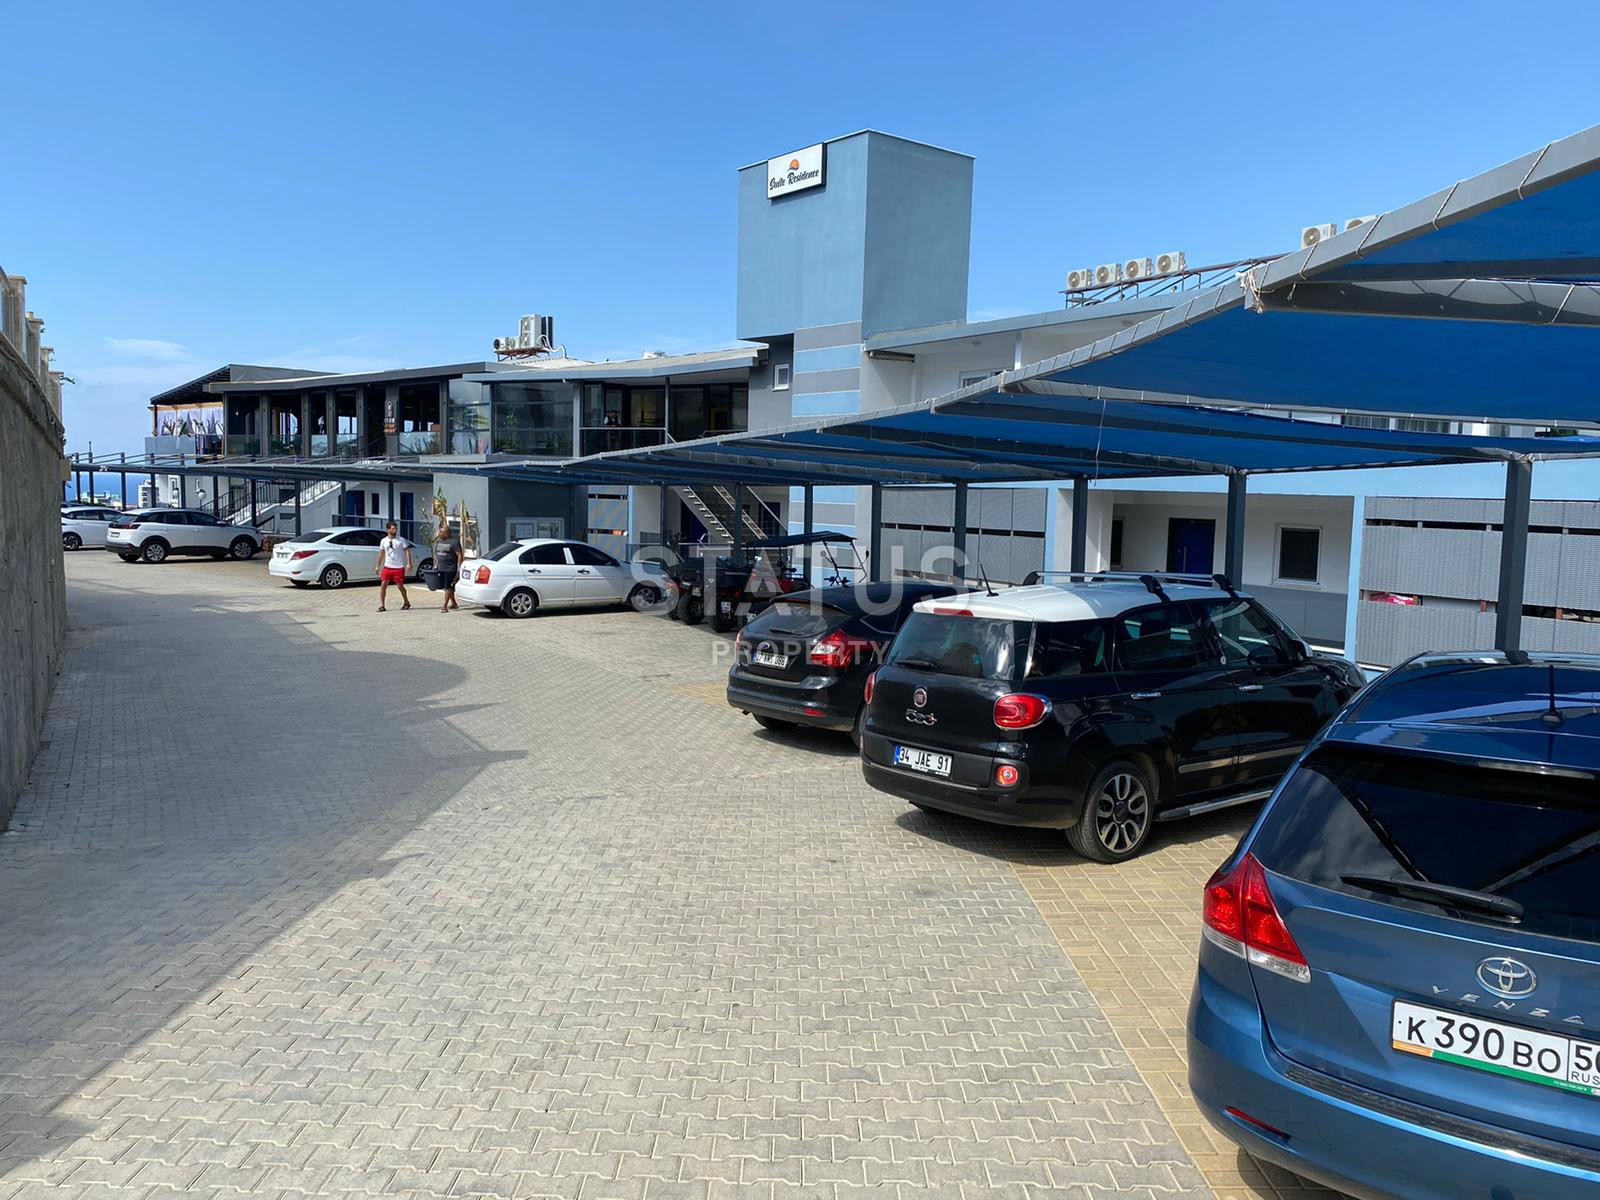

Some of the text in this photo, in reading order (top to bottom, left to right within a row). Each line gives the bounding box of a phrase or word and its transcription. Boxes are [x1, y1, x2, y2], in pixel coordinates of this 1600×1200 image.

[787, 169, 819, 185] Residence
[899, 747, 949, 771] 34 JAE 91
[1432, 984, 1585, 1025] VENZA
[1571, 1071, 1600, 1086] RUS
